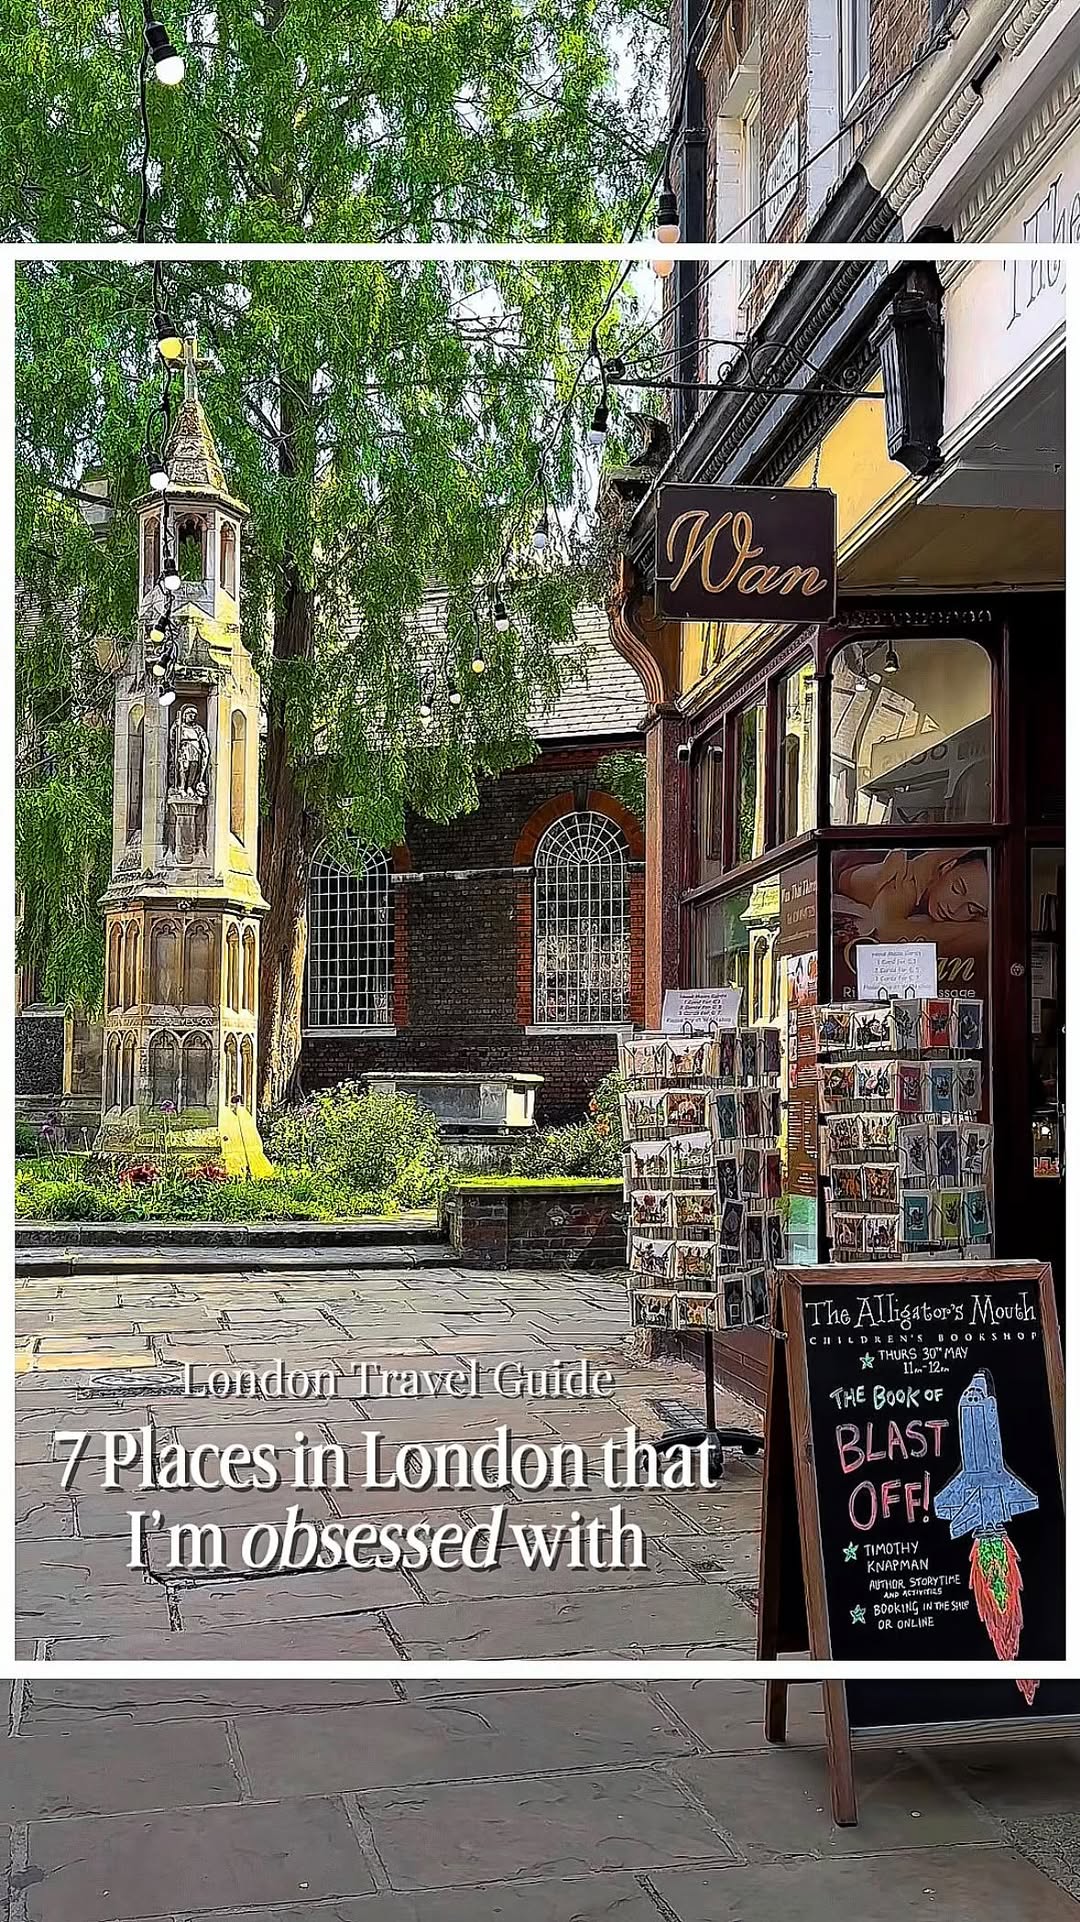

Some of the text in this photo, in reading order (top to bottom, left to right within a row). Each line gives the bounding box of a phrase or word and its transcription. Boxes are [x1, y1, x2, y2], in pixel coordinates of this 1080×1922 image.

[666, 510, 828, 596] Wan
[804, 1291, 1037, 1331] The Alligator's Mouth
[809, 1332, 1037, 1346] CHILDREN'S BOOKSHOP
[877, 1348, 918, 1361] THURS
[944, 1347, 969, 1359] MAY
[829, 1385, 944, 1410] THE BOOK OF
[836, 1419, 950, 1475] BLAST
[848, 1470, 930, 1531] OFF!
[864, 1540, 919, 1557] TIMOTHY
[867, 1558, 929, 1573] KNAPMAN
[869, 1574, 961, 1591] AUTHOR STORYTIME
[883, 1588, 943, 1599] AND ACTIVITIES
[873, 1600, 919, 1616] BOOKING
[922, 1601, 933, 1611] IN
[934, 1601, 950, 1611] THE
[878, 1617, 935, 1630] OR ONLINE
